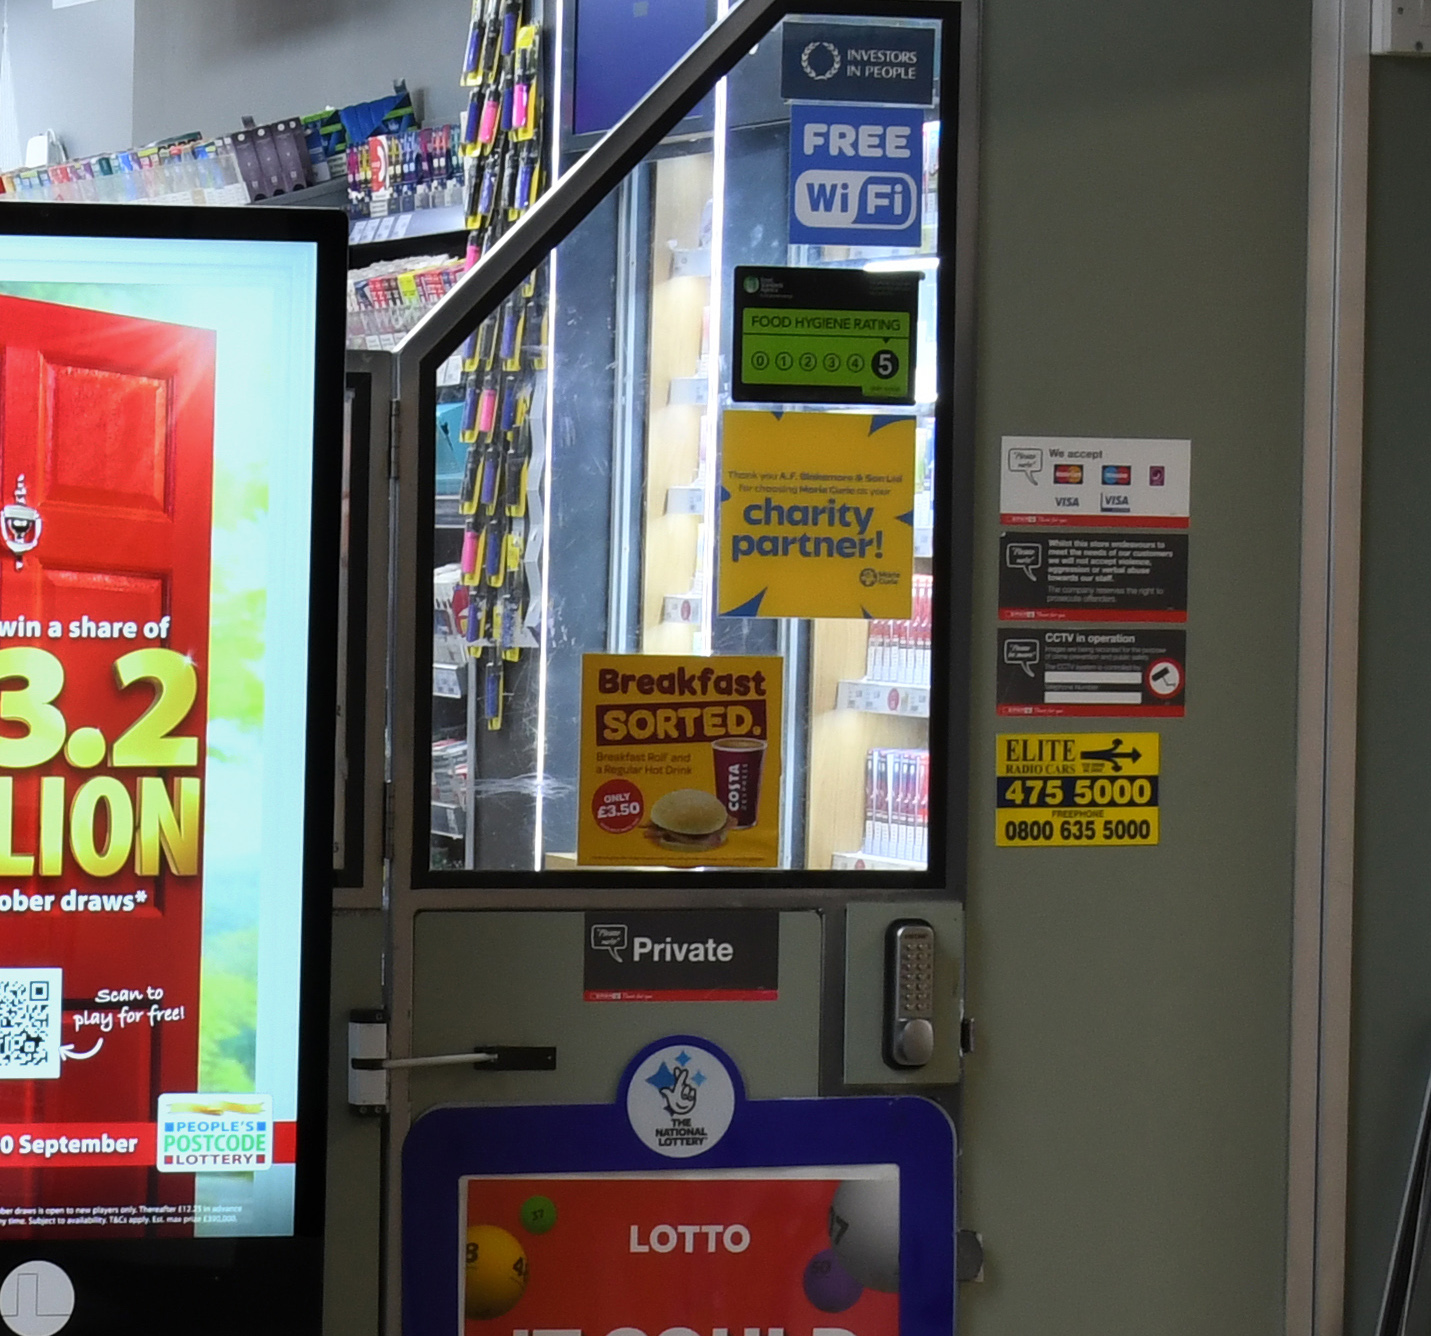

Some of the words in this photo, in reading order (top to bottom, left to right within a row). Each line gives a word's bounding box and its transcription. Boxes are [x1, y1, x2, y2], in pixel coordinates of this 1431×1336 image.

[847, 49, 917, 64] INVESTORS
[847, 66, 862, 77] IN
[864, 66, 916, 80] PEOPLE
[803, 123, 911, 158] FREE
[752, 316, 791, 328] FOOD
[795, 317, 850, 330] HYGIENE
[854, 319, 901, 331] RATING
[878, 353, 892, 375] 5
[1048, 449, 1066, 459] We
[1068, 450, 1103, 460] accept
[1055, 497, 1079, 507] VISA
[1105, 495, 1129, 506] VISA
[743, 497, 874, 535] charity
[732, 531, 883, 562] partner!
[48, 621, 62, 638] a
[69, 616, 137, 639] share
[143, 616, 171, 639] of
[1045, 632, 1074, 643] CCTV
[1076, 633, 1086, 643] in
[1087, 633, 1136, 644] operation
[598, 667, 766, 696] Breakfast
[603, 705, 762, 741] SORTED.
[596, 752, 646, 762] Breakfast
[670, 753, 691, 763] and
[1005, 739, 1075, 762] ELITE
[596, 767, 603, 775] a
[604, 765, 643, 776] Regular
[645, 766, 663, 775] Hot
[665, 765, 692, 775] Drink
[1005, 764, 1043, 774] RADIO
[1045, 764, 1075, 774] CARS
[728, 764, 741, 812] COSTA
[1005, 779, 1064, 804] 475
[1073, 778, 1152, 804] 5000
[604, 792, 630, 803] ONLY
[597, 802, 640, 819] £3.50
[1052, 810, 1104, 818] FREEPHONE
[1005, 820, 1054, 841] 0800
[1060, 819, 1096, 840] 635
[1103, 819, 1150, 840] 5000
[633, 937, 734, 962] Private
[95, 988, 143, 1003] Scan
[146, 986, 164, 1001] to
[73, 1009, 114, 1032] play
[117, 1007, 144, 1028] for
[147, 1005, 185, 1027] free!
[671, 1118, 692, 1127] THE
[655, 1127, 708, 1137] NATIONAL
[19, 1134, 138, 1159] September
[164, 1134, 266, 1152] POSTCODE
[658, 1137, 705, 1147] LOTTERY
[176, 1154, 253, 1165] LOTTERY
[93, 1205, 119, 1215] players
[629, 1223, 751, 1253] LOTTO
